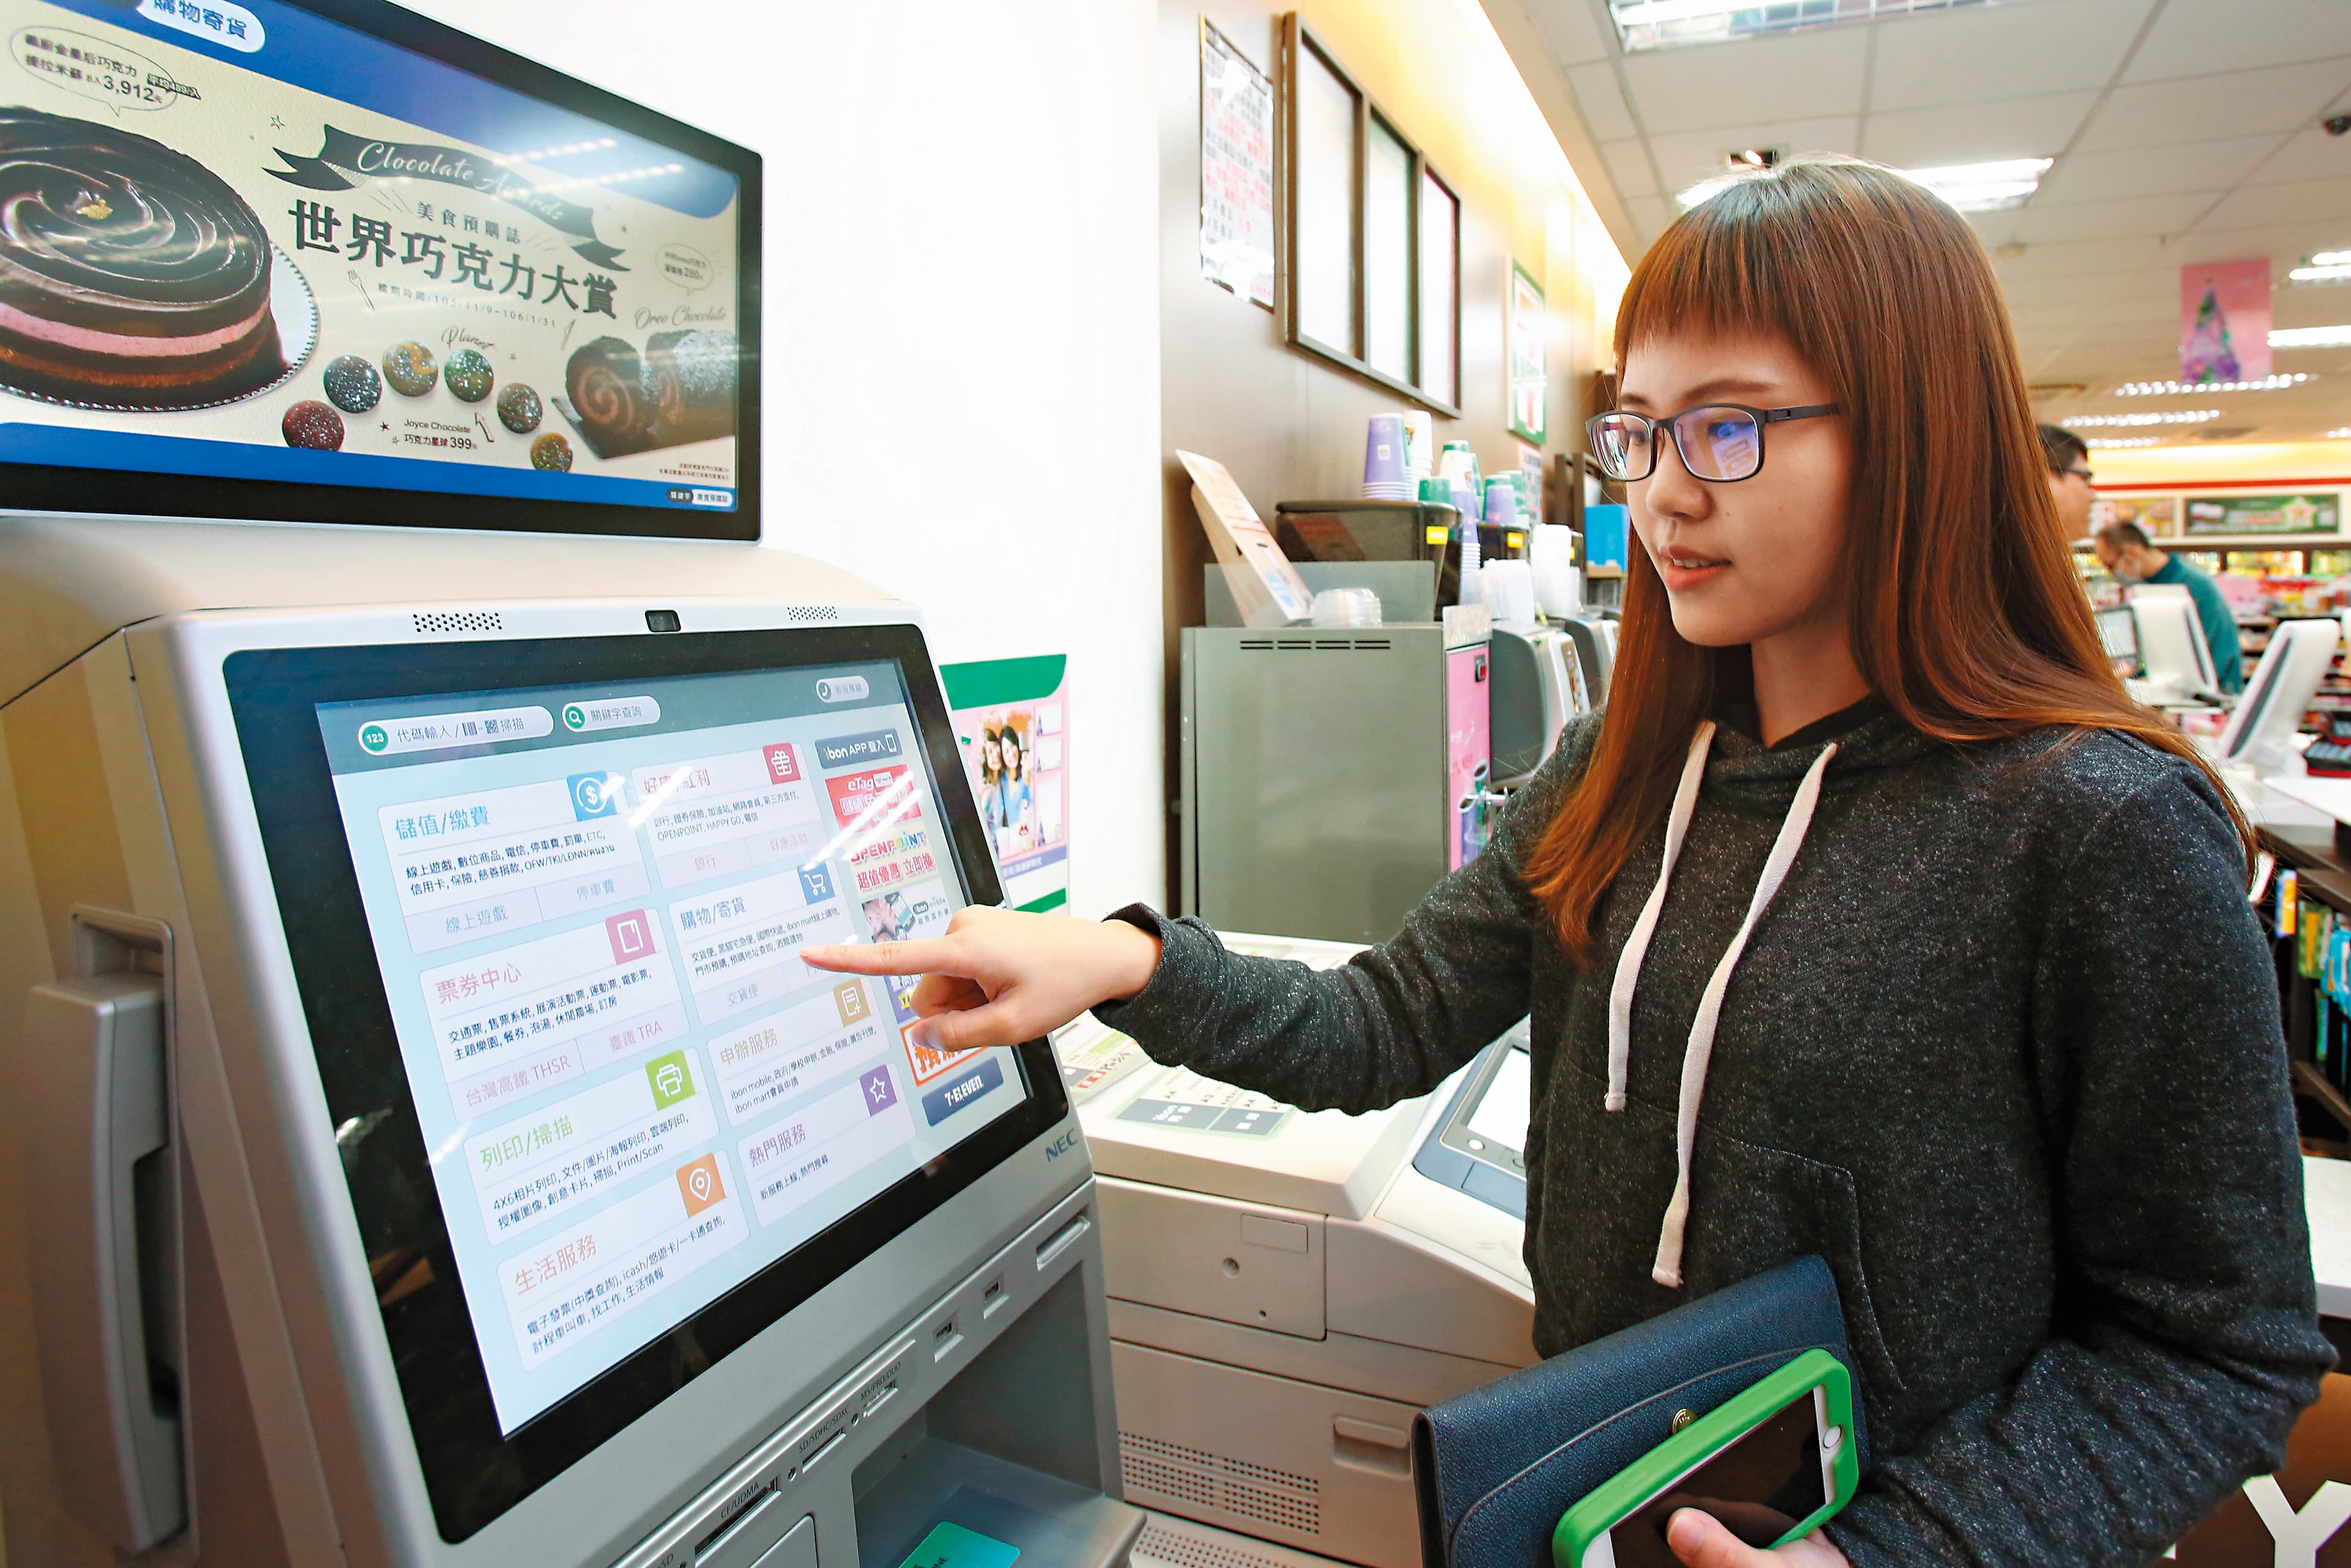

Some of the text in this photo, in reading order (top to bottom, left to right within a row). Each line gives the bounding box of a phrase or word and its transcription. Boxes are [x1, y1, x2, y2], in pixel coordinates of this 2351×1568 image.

[418, 201, 521, 245] 美食預購誌
[287, 198, 617, 320] 世界巧克力大賞
[634, 304, 727, 329] Oreo Chocolate
[404, 418, 471, 433] Joyce Chocolate
[500, 718, 525, 733] 掃描
[591, 705, 643, 721] 關鍵字查詢
[366, 732, 384, 745] 123
[849, 742, 867, 756] APP
[868, 739, 886, 754] 登入
[847, 776, 874, 791] eTag
[395, 805, 490, 841] 儲值/繳費
[694, 853, 717, 872] 銀行
[857, 862, 902, 890] 超值優惠
[576, 879, 615, 901] 停車費
[445, 905, 509, 936] 線上遊戲
[680, 896, 748, 931] 購物/寄貨
[435, 961, 523, 1005] 票券中心
[726, 982, 760, 1007] 交貨便
[637, 1020, 663, 1041] TRA
[720, 1027, 779, 1066] 申辦服務
[466, 1054, 571, 1107] 台灣高鐵 THSR
[730, 1086, 748, 1100] ibon
[735, 1099, 752, 1114] ibon
[479, 1114, 574, 1172] 列印/掃描
[617, 1142, 664, 1172] Print/Scan
[748, 1123, 807, 1168] 熱門服務
[1044, 1127, 1079, 1163] NEC
[514, 1234, 598, 1296] 生活服務
[625, 1268, 665, 1300] 生活情報
[798, 1404, 850, 1454] SD/SDHC/SDXC
[721, 1481, 760, 1519] CF/UDMA
